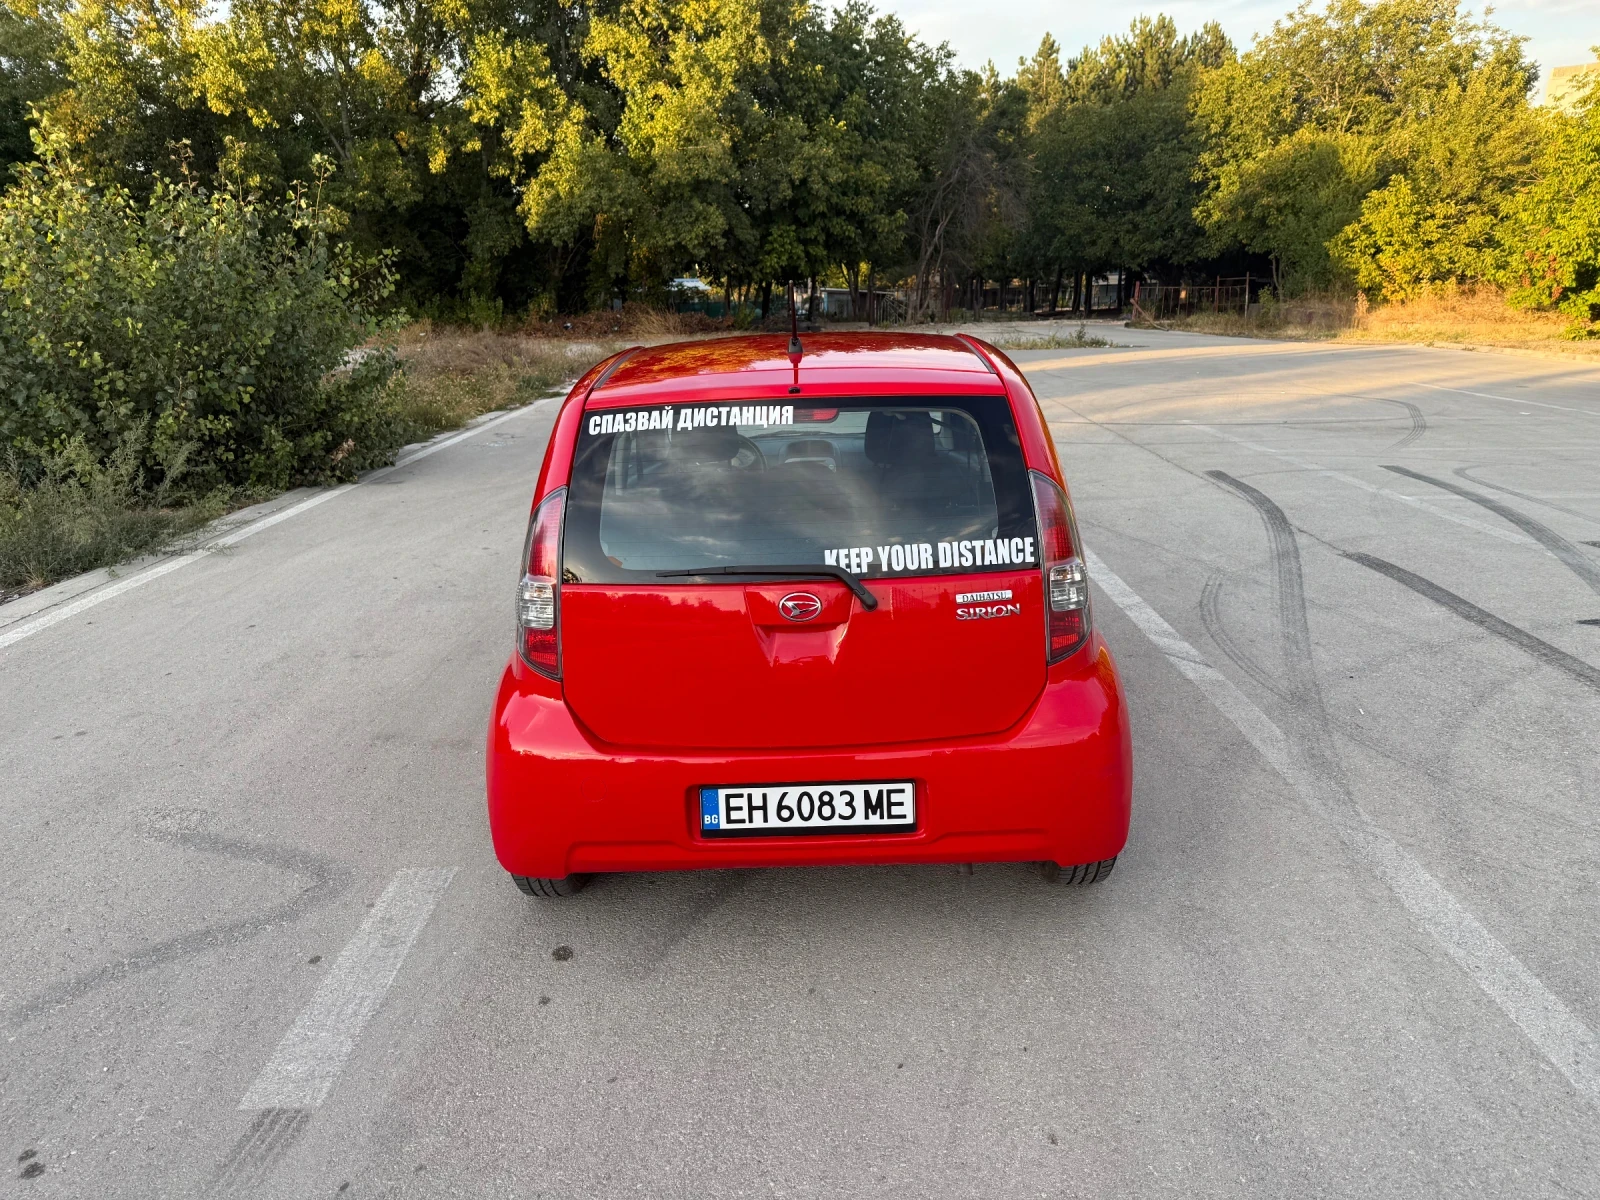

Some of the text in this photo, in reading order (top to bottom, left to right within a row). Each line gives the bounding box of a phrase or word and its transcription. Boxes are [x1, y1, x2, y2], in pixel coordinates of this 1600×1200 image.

[588, 405, 794, 435] СПАЗВАЙ ДИСТАНЦИЯ
[824, 537, 1035, 574] KEEP YOUR DISTANCE
[962, 592, 1008, 603] DAIHATSU
[955, 603, 1021, 620] SIRION
[776, 790, 857, 823] 6083
[704, 815, 719, 825] BG
